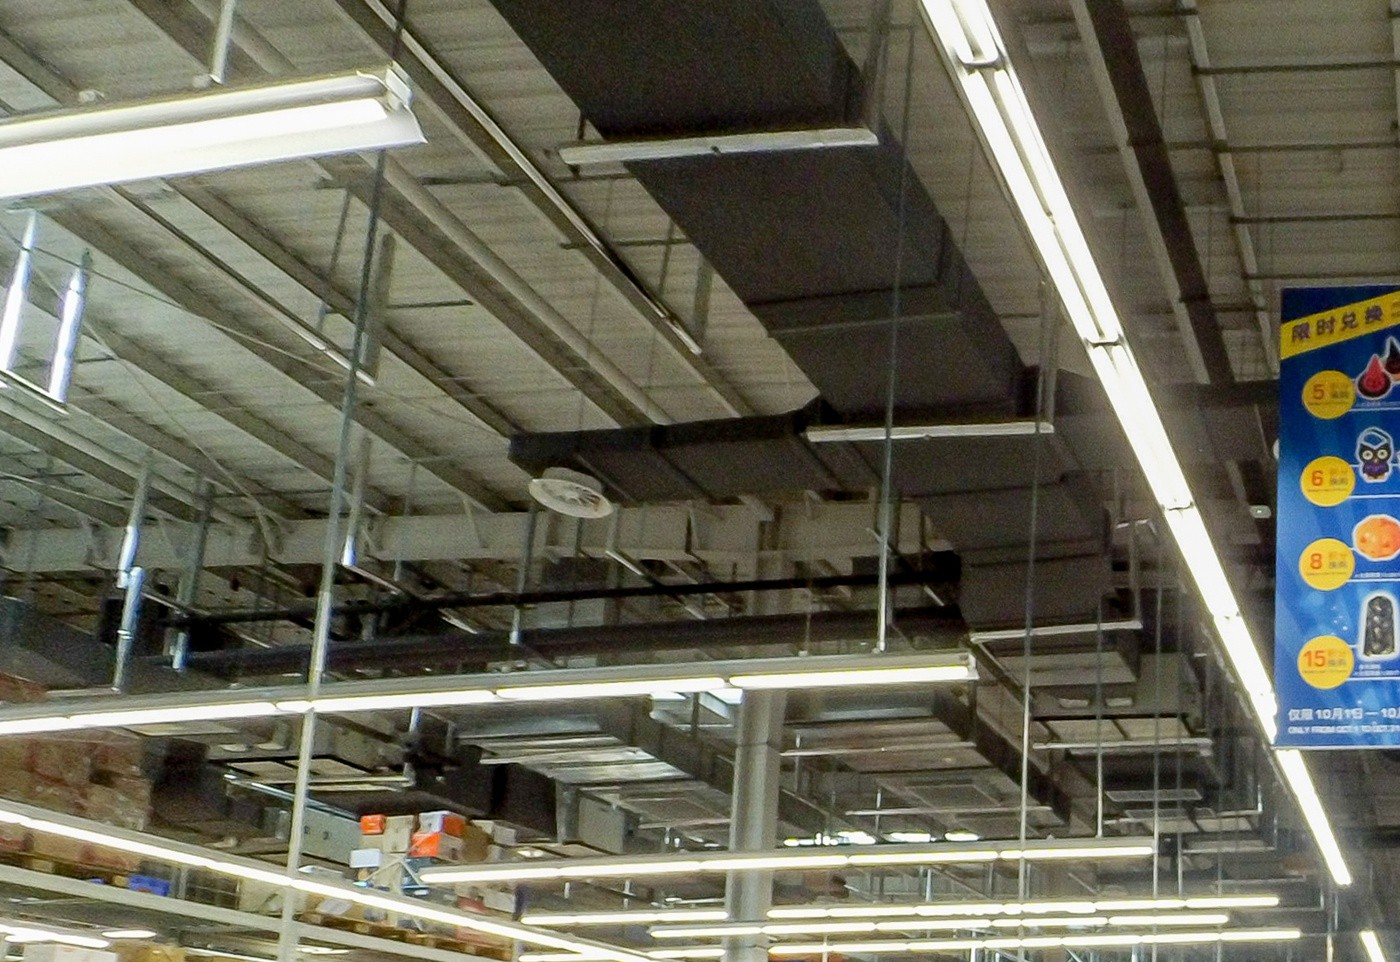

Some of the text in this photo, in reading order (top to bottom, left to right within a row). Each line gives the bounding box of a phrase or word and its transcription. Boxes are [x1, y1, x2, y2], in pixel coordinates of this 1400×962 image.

[1313, 384, 1324, 400] 5
[1312, 470, 1323, 485] 6
[1310, 553, 1323, 569] 8
[1303, 651, 1326, 667] 15
